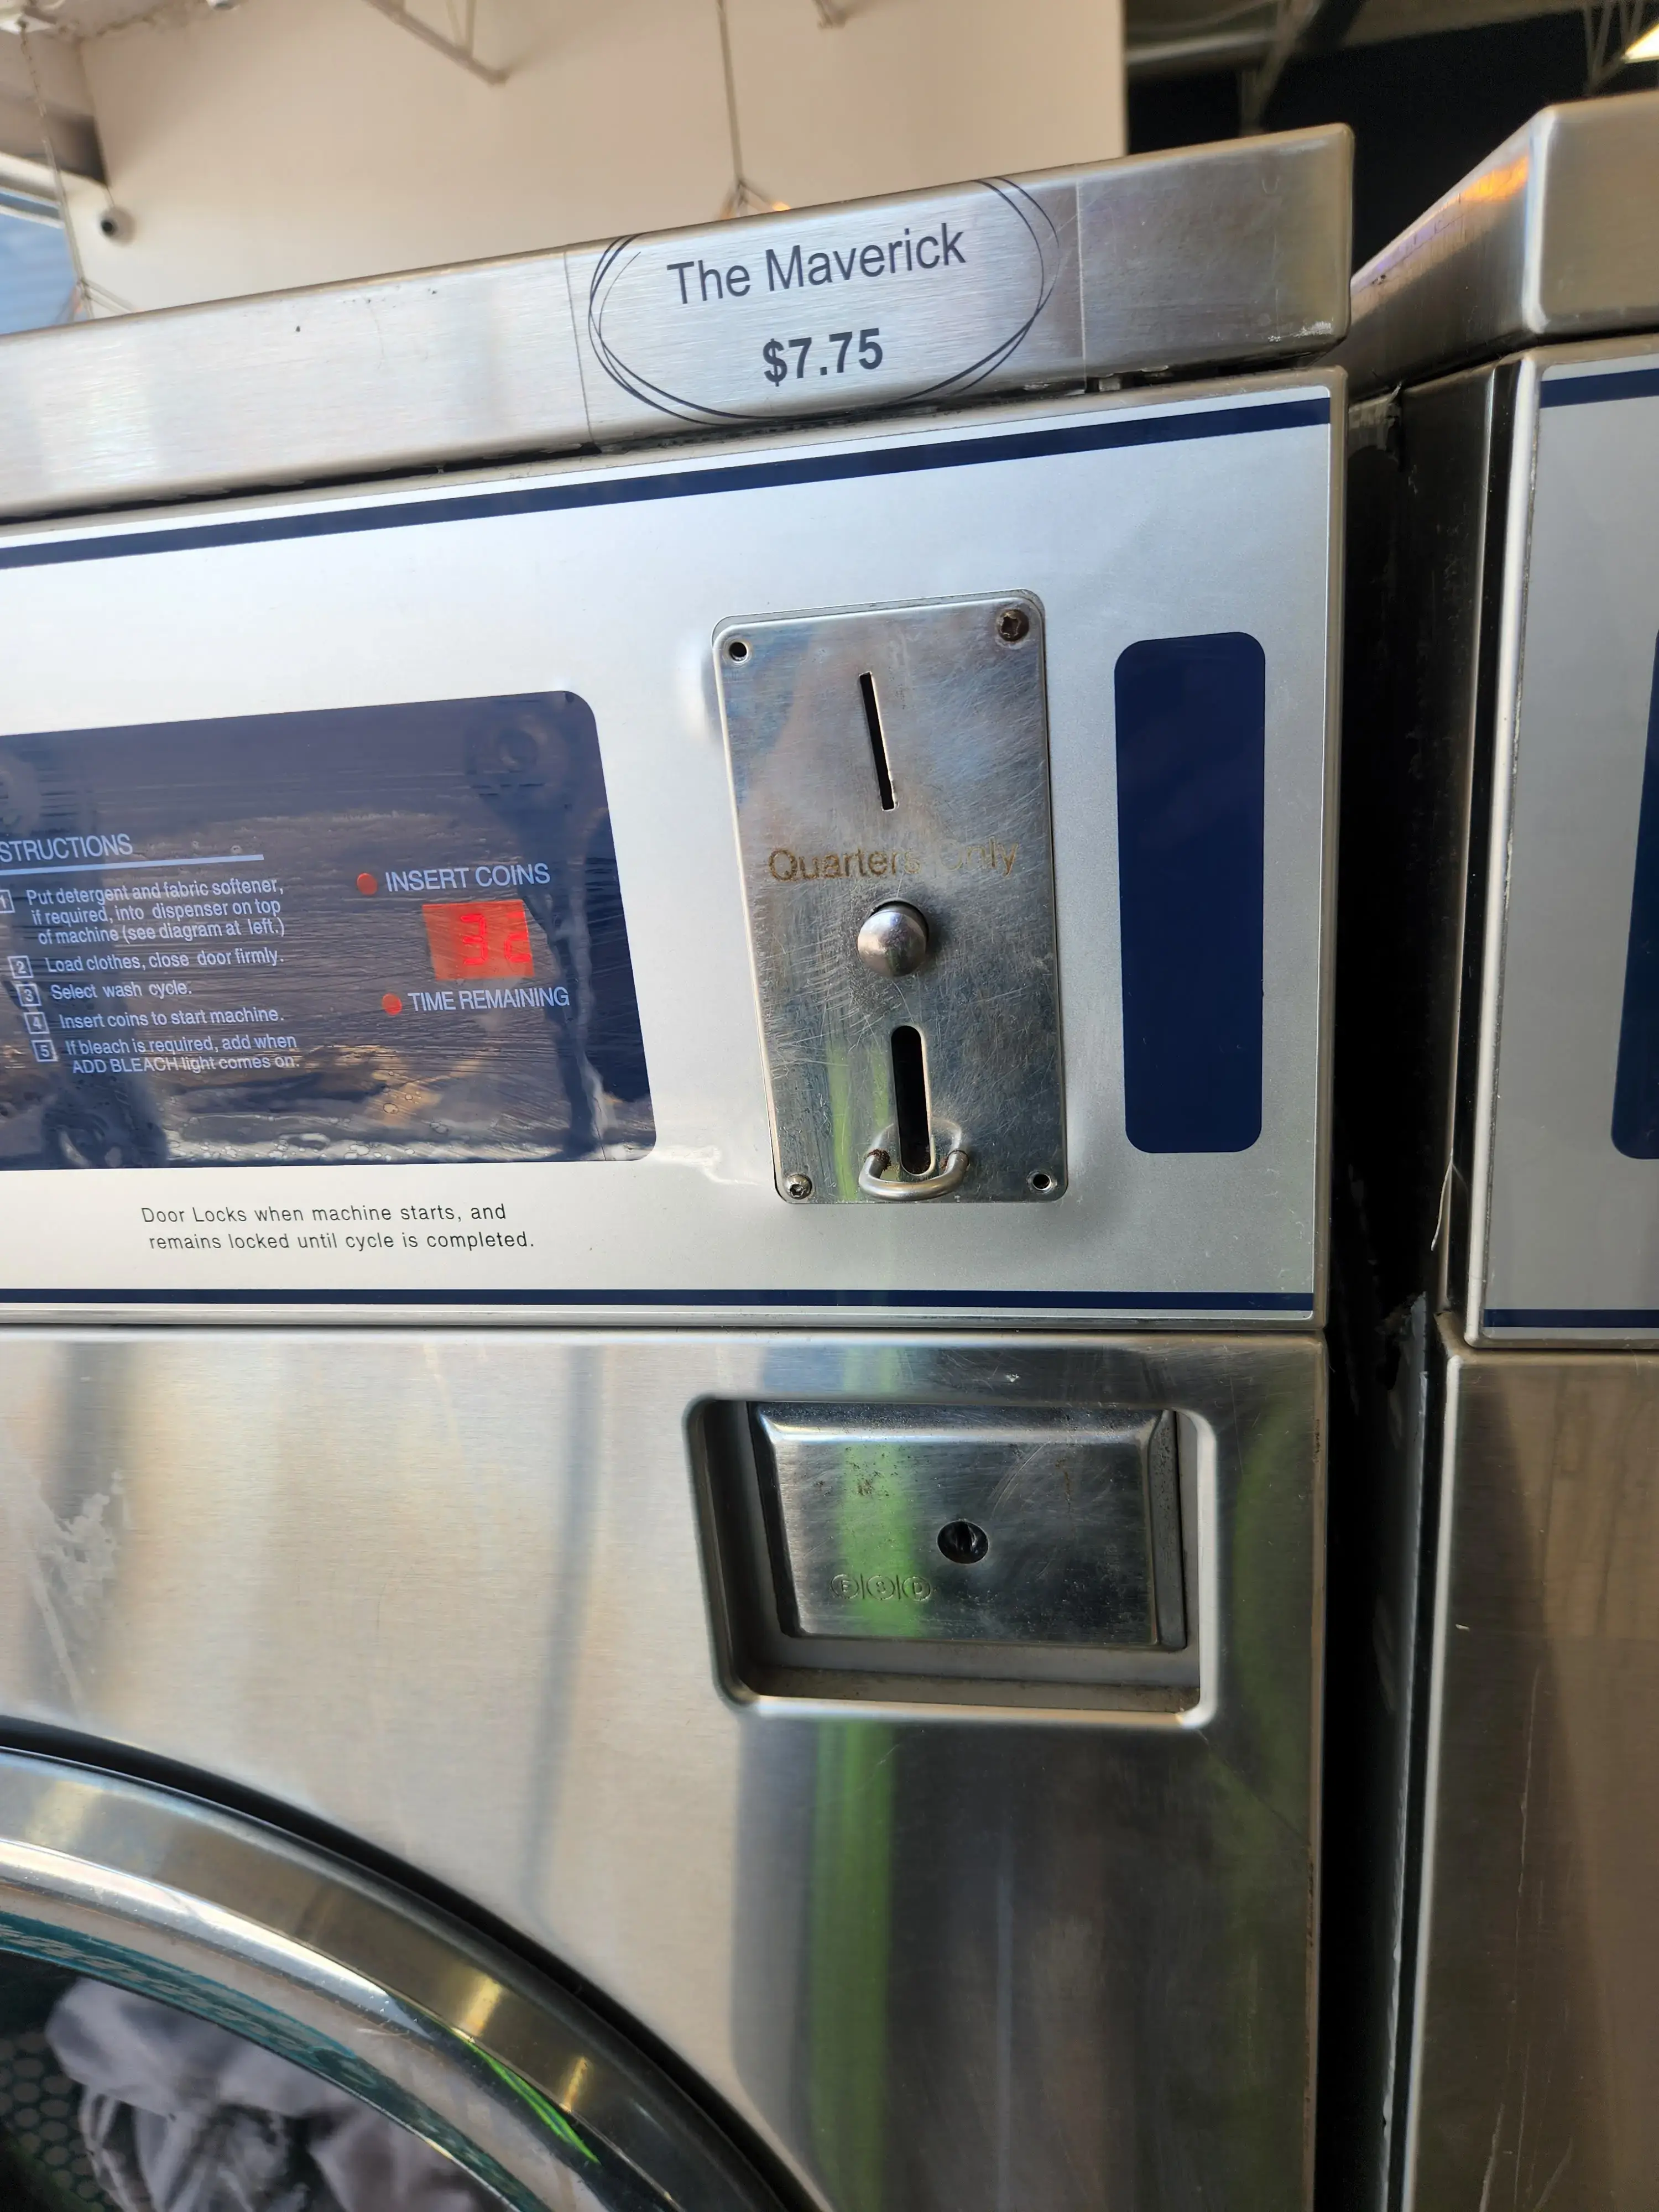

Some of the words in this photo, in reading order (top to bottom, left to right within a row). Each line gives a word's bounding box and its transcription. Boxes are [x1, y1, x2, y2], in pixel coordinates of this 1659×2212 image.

[666, 259, 750, 304] The
[766, 223, 966, 291] Maverick
[763, 328, 884, 387] $7.75
[768, 847, 921, 881] Quarters
[385, 867, 469, 892] INSERT
[476, 863, 550, 887] COINS
[27, 889, 54, 905] Put
[56, 885, 129, 905] detergent
[132, 882, 161, 899] and
[164, 881, 208, 898] fabric
[212, 878, 284, 894] softener,
[32, 910, 43, 925] if
[45, 907, 113, 927] required,
[114, 905, 144, 921] into
[153, 904, 228, 922] dispenser
[233, 903, 252, 915] on
[255, 898, 281, 916] top
[38, 929, 53, 945] of
[55, 927, 119, 943] machine
[122, 925, 155, 944] (see
[159, 922, 222, 941] diagram
[226, 922, 240, 935] at
[247, 918, 285, 937] left.)
[16, 962, 26, 974] 2
[45, 956, 84, 973] Load
[86, 952, 145, 971] clothes,
[149, 951, 189, 967] close
[197, 950, 232, 965] door
[235, 947, 285, 967] firmly.
[24, 990, 34, 1002] 3
[51, 984, 97, 1000] Select
[102, 981, 142, 997] wash
[408, 991, 456, 1011] TIME
[460, 986, 570, 1010] REMAINING
[32, 1018, 42, 1030] 4
[59, 1014, 105, 1029] Insert
[107, 1012, 149, 1027] coins
[151, 1013, 166, 1025] to
[171, 1011, 206, 1025] start
[210, 1008, 284, 1024] machine.
[40, 1046, 49, 1057] 5
[65, 1040, 78, 1055] If
[78, 1039, 129, 1055] bleach
[133, 1039, 145, 1053] is
[149, 1038, 218, 1056] required,
[223, 1036, 251, 1050] add
[253, 1034, 297, 1049] when
[72, 1060, 107, 1074] ADD
[111, 1057, 179, 1073] BLEACH
[182, 1055, 216, 1073] light
[220, 1055, 270, 1070] comes
[275, 1055, 299, 1068] on.
[141, 1207, 185, 1223] Door
[192, 1206, 247, 1223] Locks
[254, 1206, 304, 1222] when
[312, 1205, 392, 1221] machine
[400, 1205, 462, 1223] starts,
[471, 1204, 506, 1220] and
[149, 1233, 221, 1249] remains
[229, 1234, 290, 1249] locked
[298, 1233, 337, 1248] until
[346, 1233, 394, 1251] cycle
[403, 1233, 418, 1248] is
[427, 1232, 534, 1251] completed.
